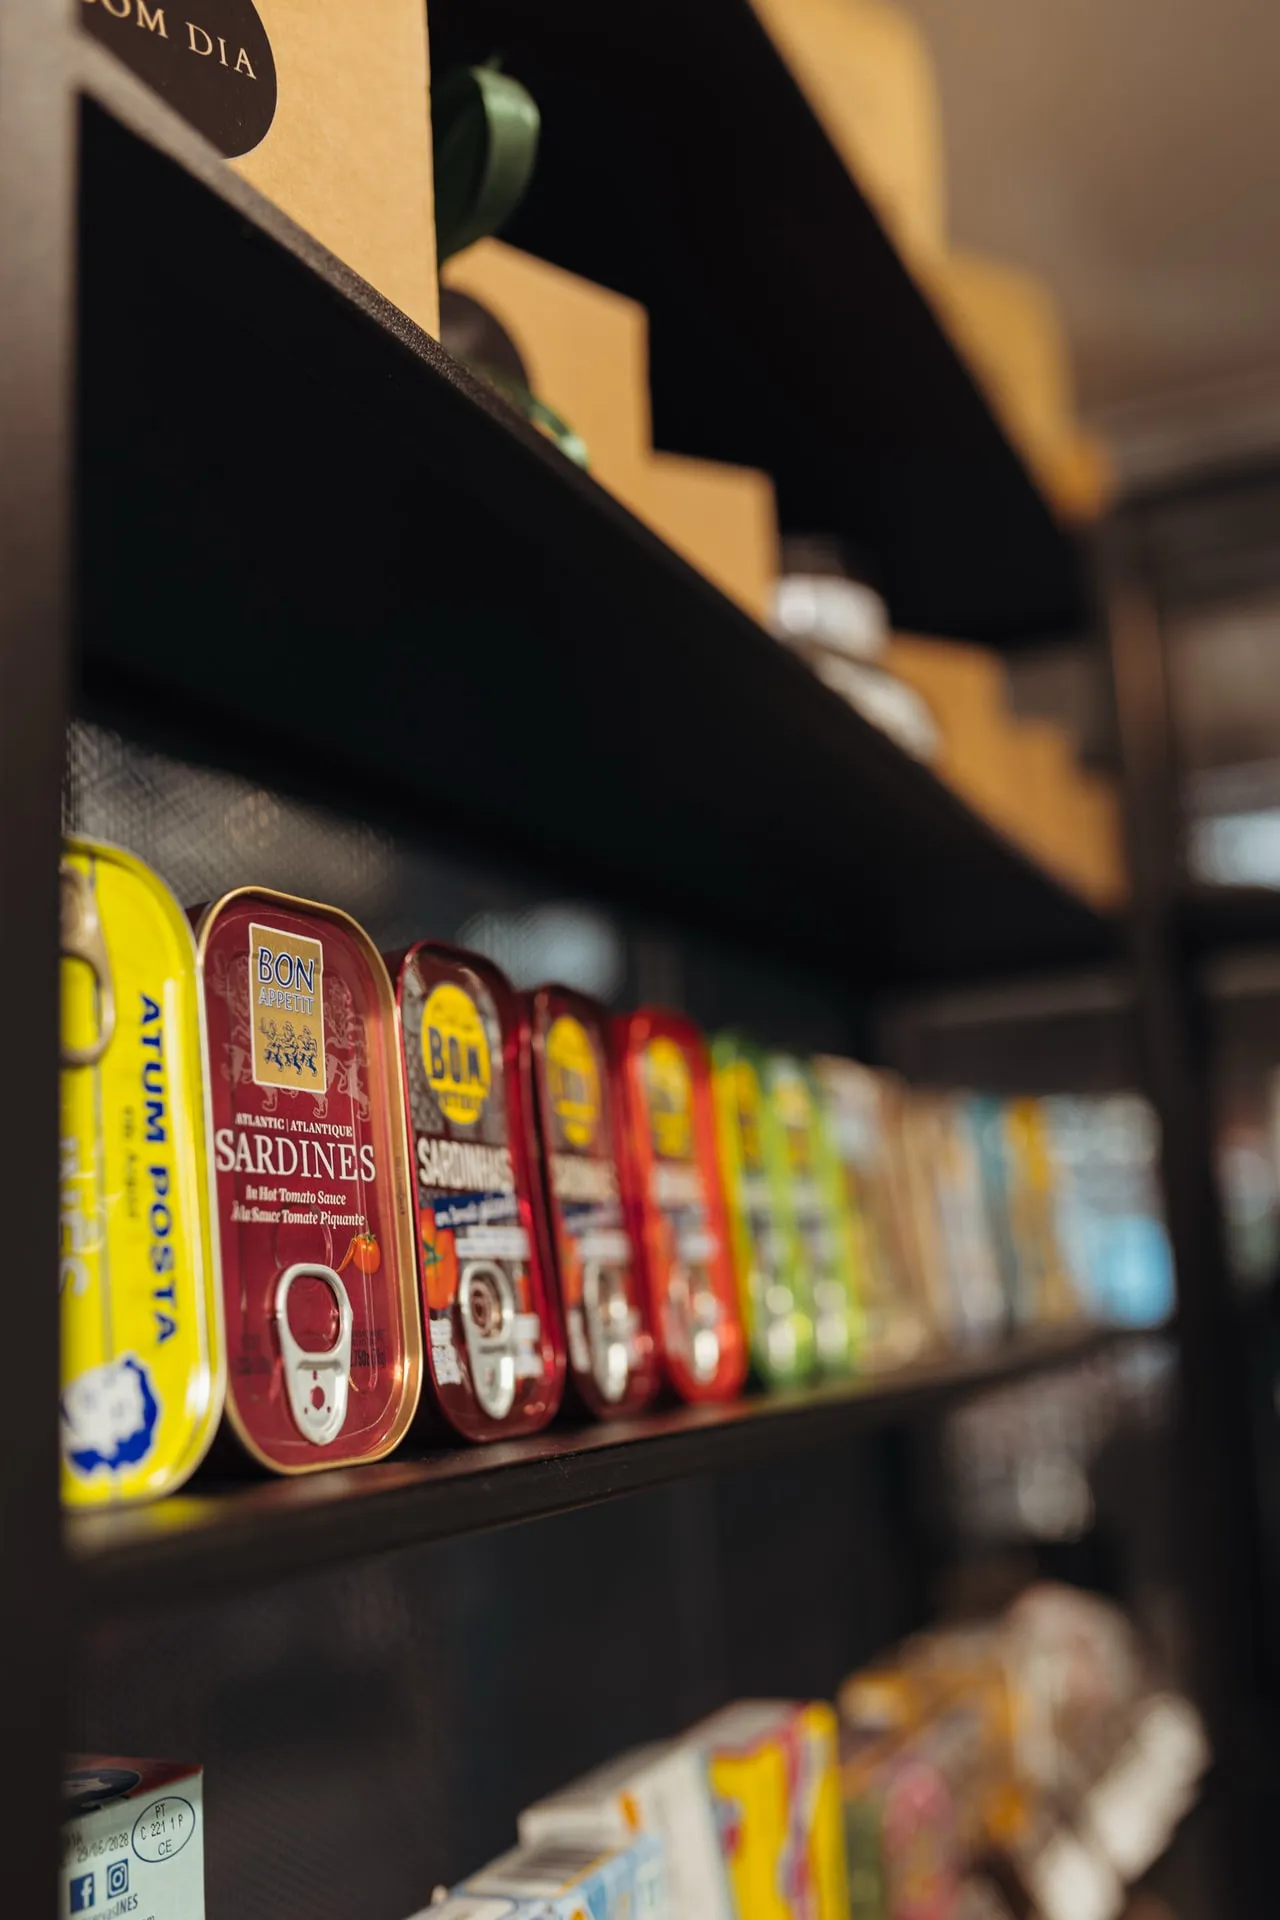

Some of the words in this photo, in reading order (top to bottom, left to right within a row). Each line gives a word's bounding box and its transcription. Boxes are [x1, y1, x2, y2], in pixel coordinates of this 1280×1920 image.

[86, 0, 168, 39] OM
[185, 21, 257, 80] DIA
[257, 946, 315, 994] BON
[258, 987, 315, 1015] APPETIT
[140, 993, 166, 1143] ATUM
[235, 1112, 285, 1130] ATLANTIC
[290, 1120, 353, 1139] ATLANTIQUE
[215, 1128, 376, 1182] SARDINES
[246, 1184, 257, 1200] In
[259, 1186, 278, 1202] Hot
[279, 1188, 316, 1205] Tomato
[317, 1191, 346, 1205] Sauce
[281, 1209, 318, 1225] Tomate
[319, 1211, 365, 1229] Piquante
[149, 1165, 178, 1344] POSTA
[155, 1803, 166, 1819] PT
[157, 1839, 173, 1856] CE
